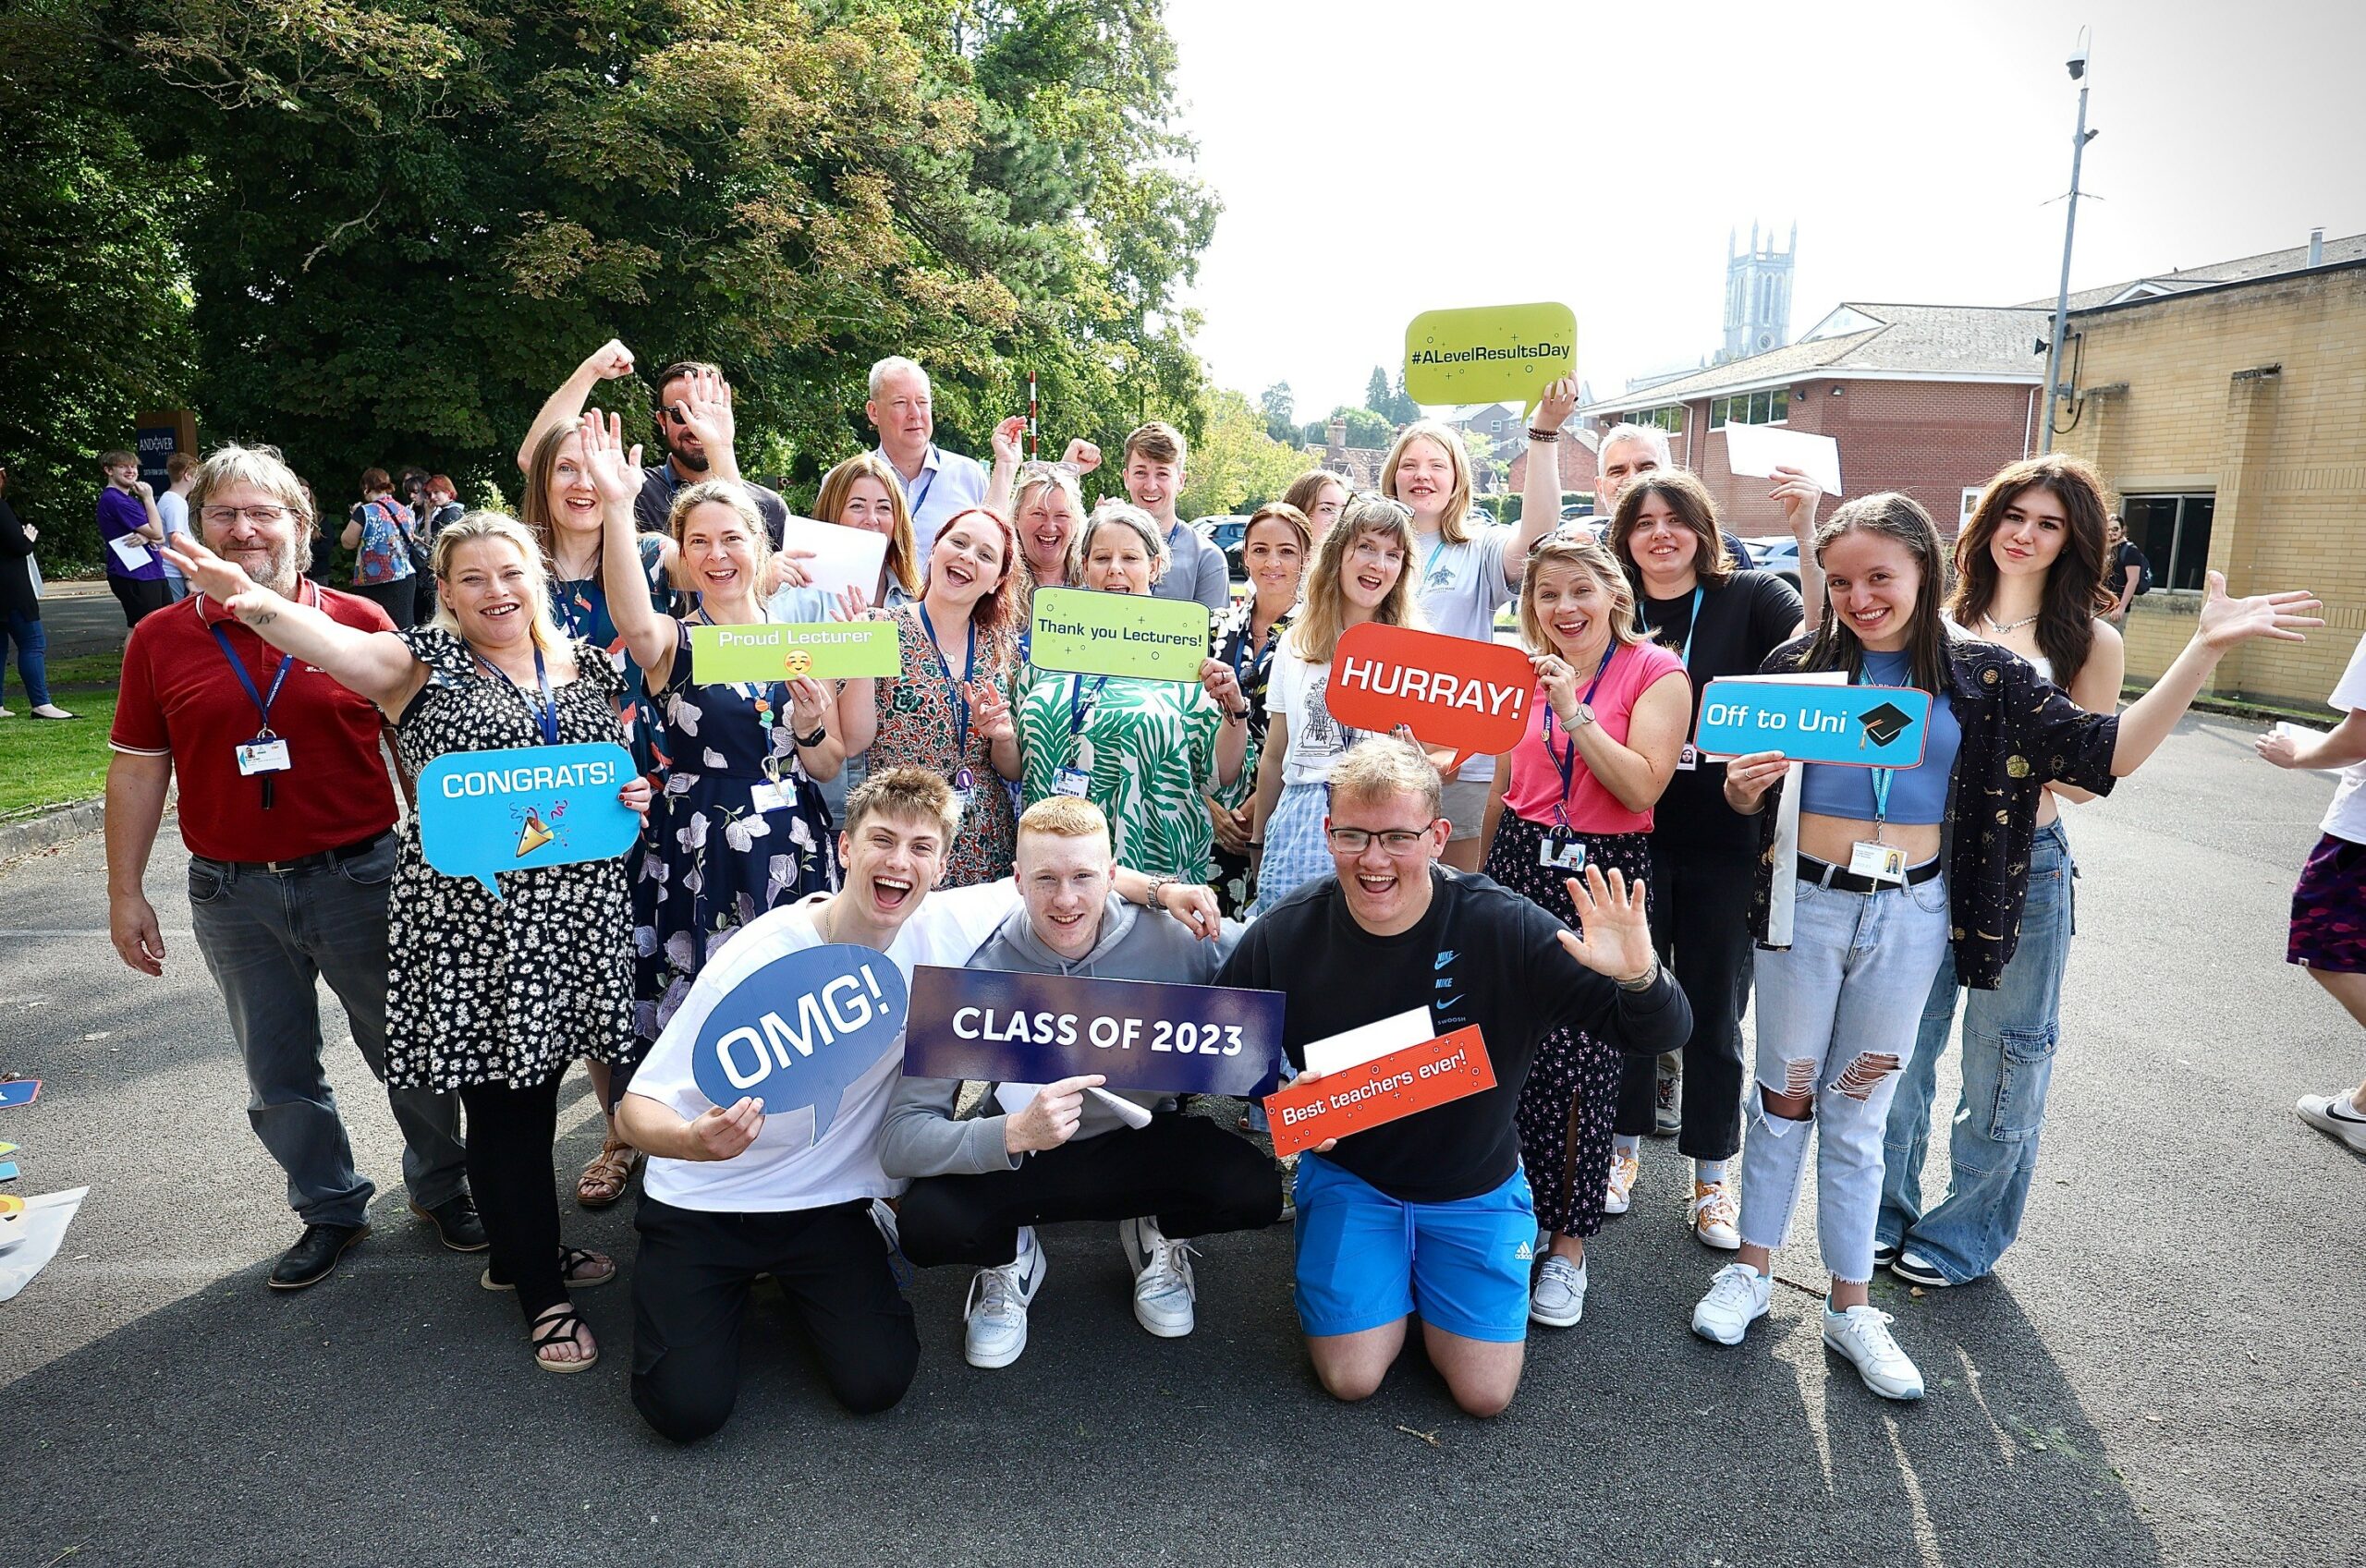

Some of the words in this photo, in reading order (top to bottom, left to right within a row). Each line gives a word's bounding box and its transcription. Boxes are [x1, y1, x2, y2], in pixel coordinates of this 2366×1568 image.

[1412, 343, 1570, 364] #ALevelResultsDay
[140, 436, 174, 451] ANDOVER
[718, 630, 780, 647] Proud
[787, 629, 873, 645] Lecturer
[1038, 618, 1085, 636] Thank
[1091, 627, 1117, 640] you
[1123, 627, 1202, 647] Lecturers!
[1340, 656, 1525, 720] HURRAY!
[1706, 703, 1750, 727] Off
[1757, 709, 1787, 729] to
[1799, 708, 1848, 734] Uni
[442, 760, 616, 798] CONGRATS!
[1437, 950, 1454, 962] NIKE
[1435, 978, 1453, 989] NIKE
[716, 964, 890, 1089] OMG!
[952, 1006, 1079, 1046] CLASS
[1088, 1015, 1143, 1050] OF
[1151, 1020, 1243, 1056] 2023
[1437, 1016, 1466, 1026] SWOOSH
[1282, 1099, 1327, 1126] Best
[1329, 1069, 1414, 1110] teachers
[1419, 1048, 1468, 1079] ever!
[1515, 1253, 1533, 1261] adida
